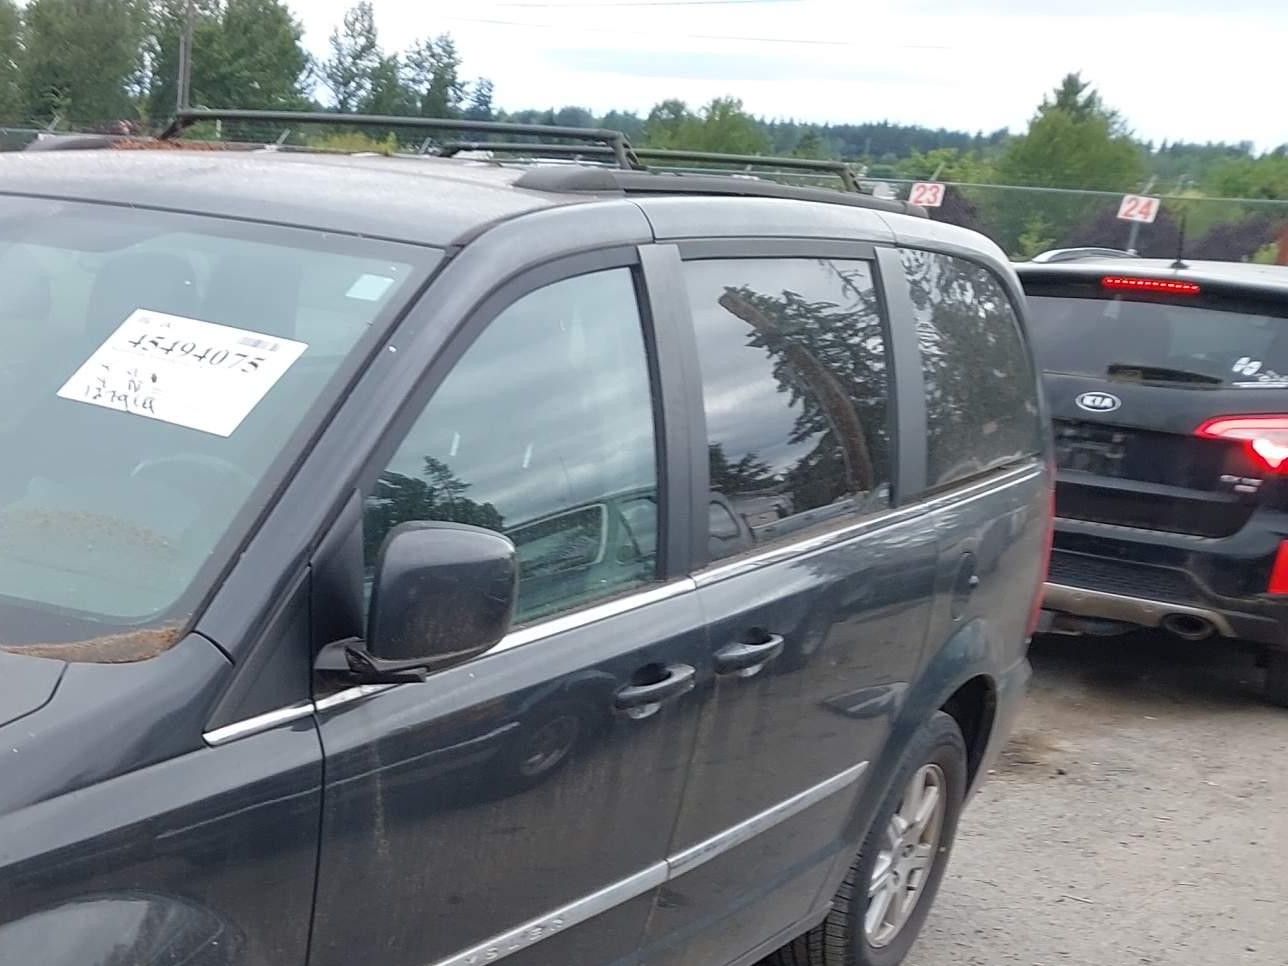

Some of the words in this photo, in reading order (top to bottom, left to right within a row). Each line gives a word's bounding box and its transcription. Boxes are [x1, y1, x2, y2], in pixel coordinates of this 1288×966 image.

[912, 184, 940, 205] 23
[1124, 198, 1152, 219] 24
[128, 333, 266, 373] 45494075
